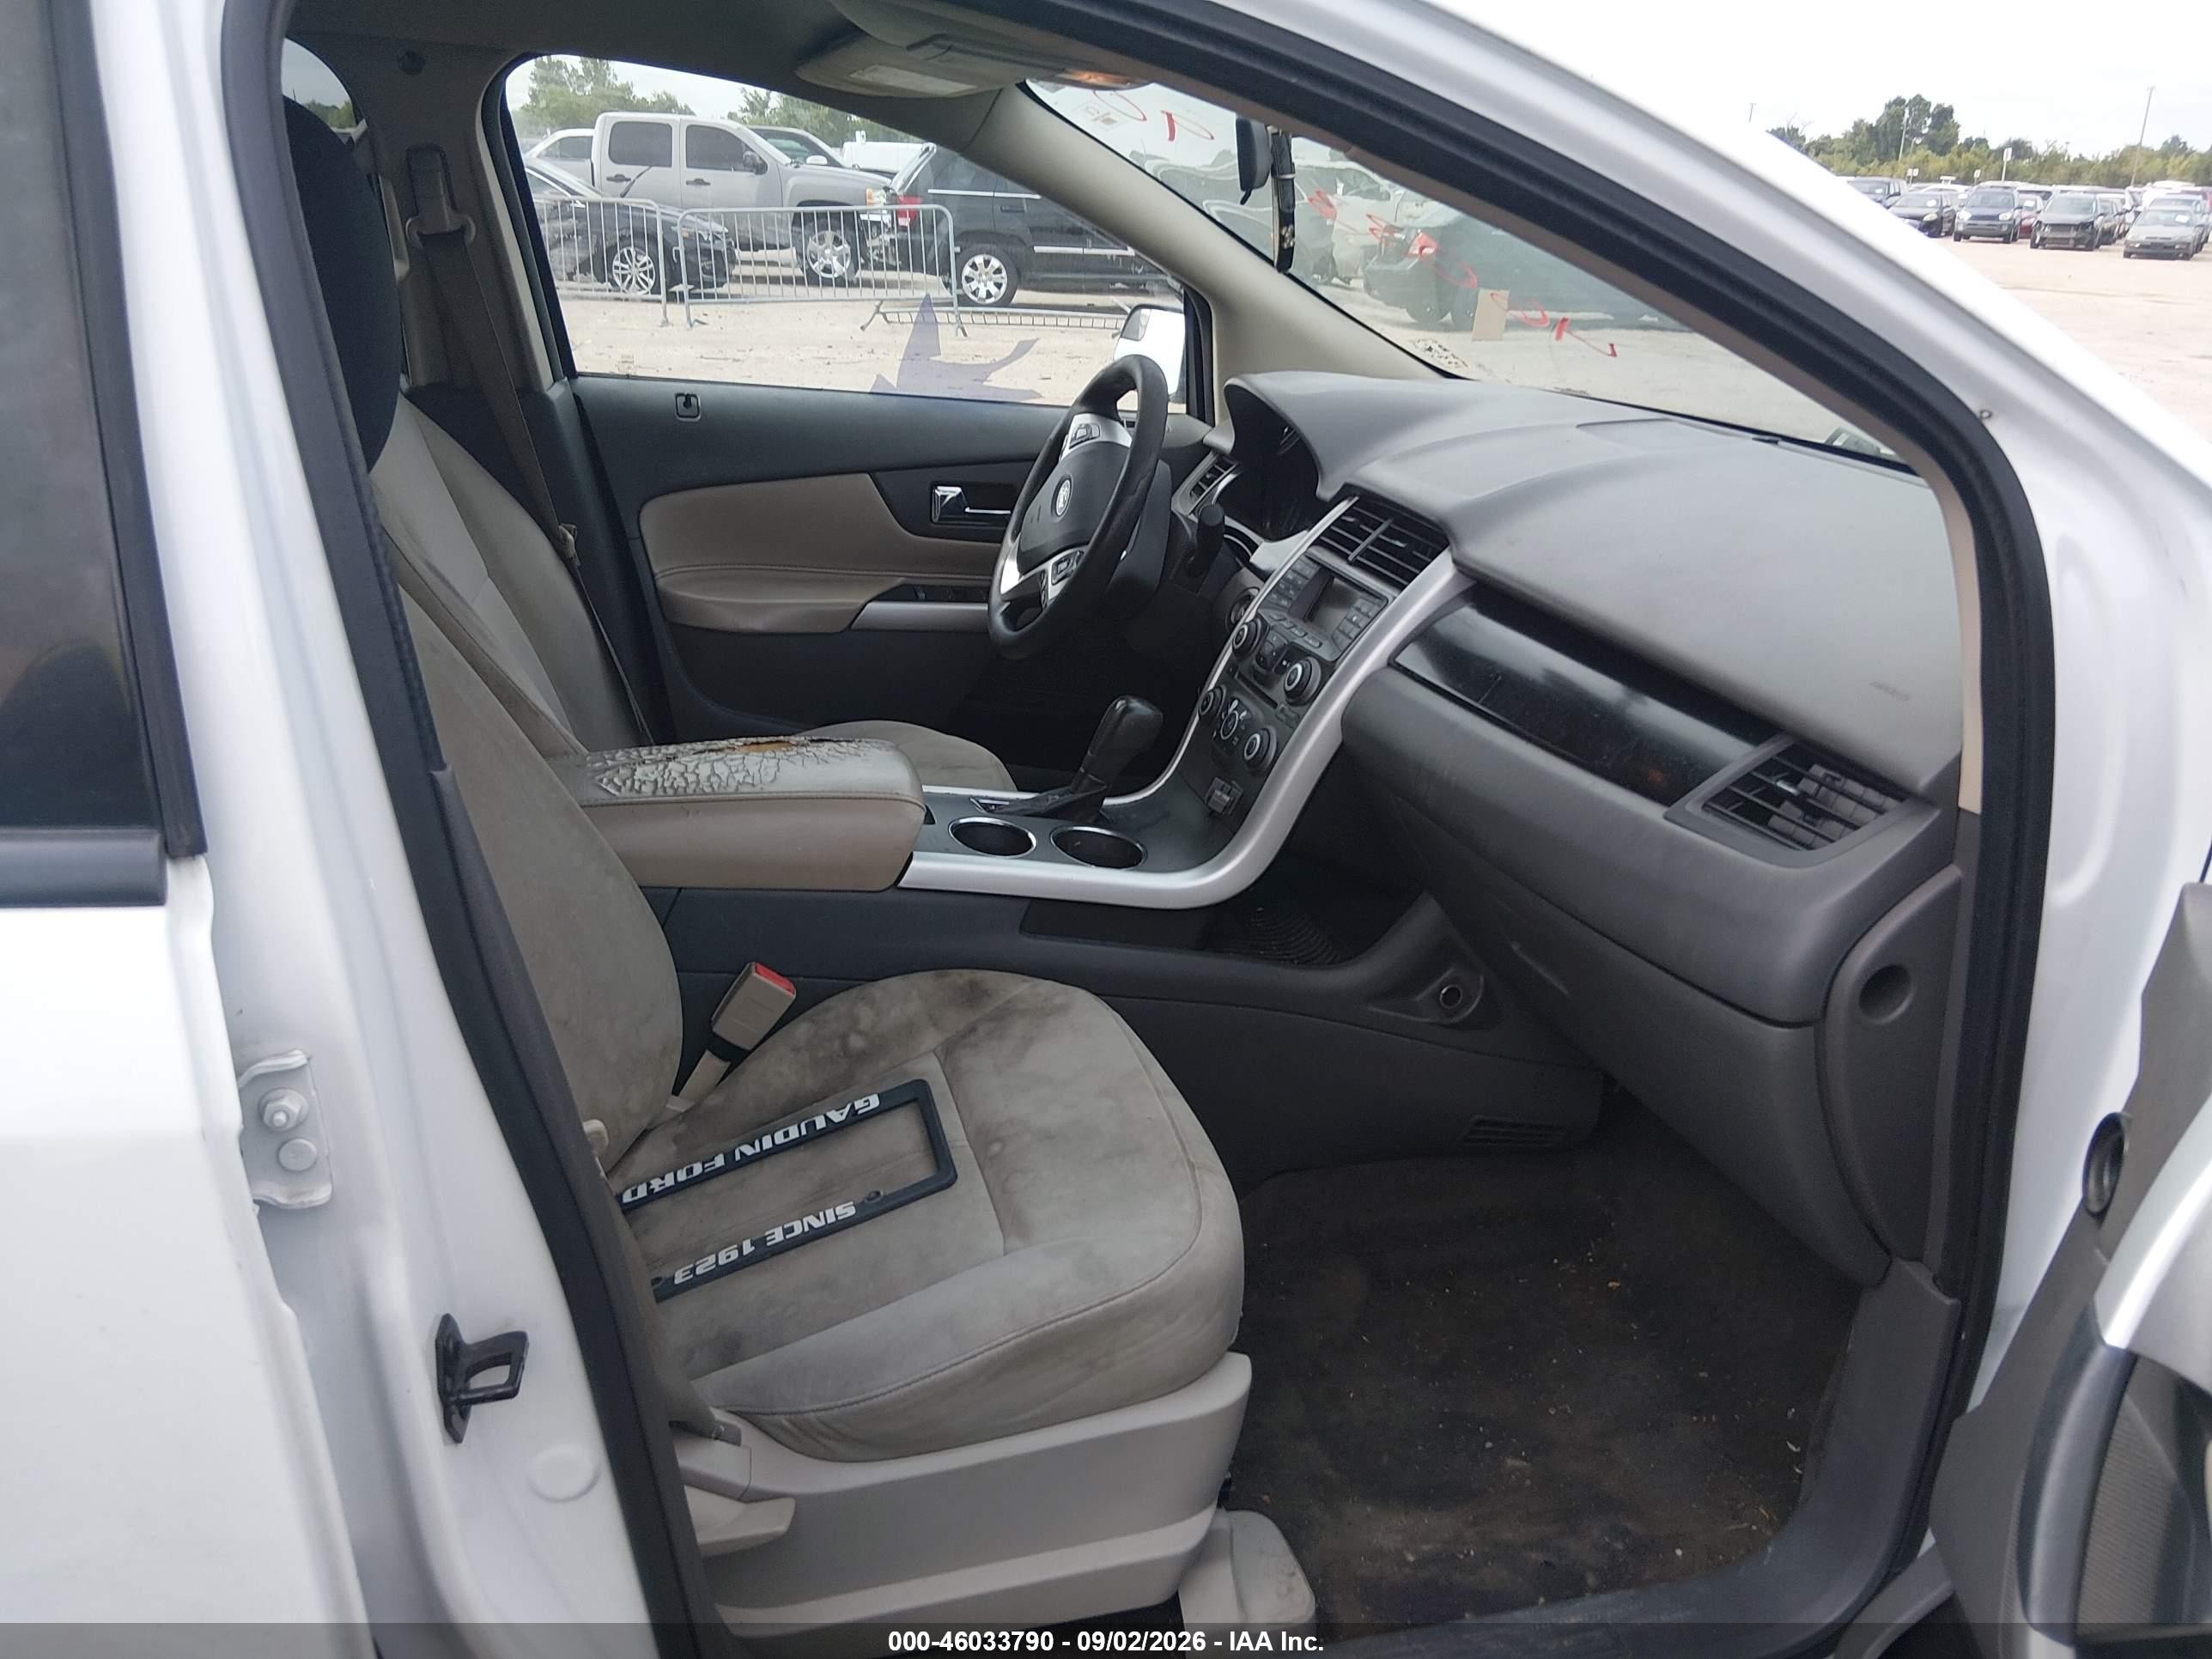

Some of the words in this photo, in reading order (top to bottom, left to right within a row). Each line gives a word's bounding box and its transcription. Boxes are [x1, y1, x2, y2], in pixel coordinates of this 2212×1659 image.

[734, 1093, 881, 1162] GAUDIN
[622, 1153, 726, 1203] FORD
[765, 1201, 857, 1247] SINCE
[673, 1238, 756, 1285] 1923
